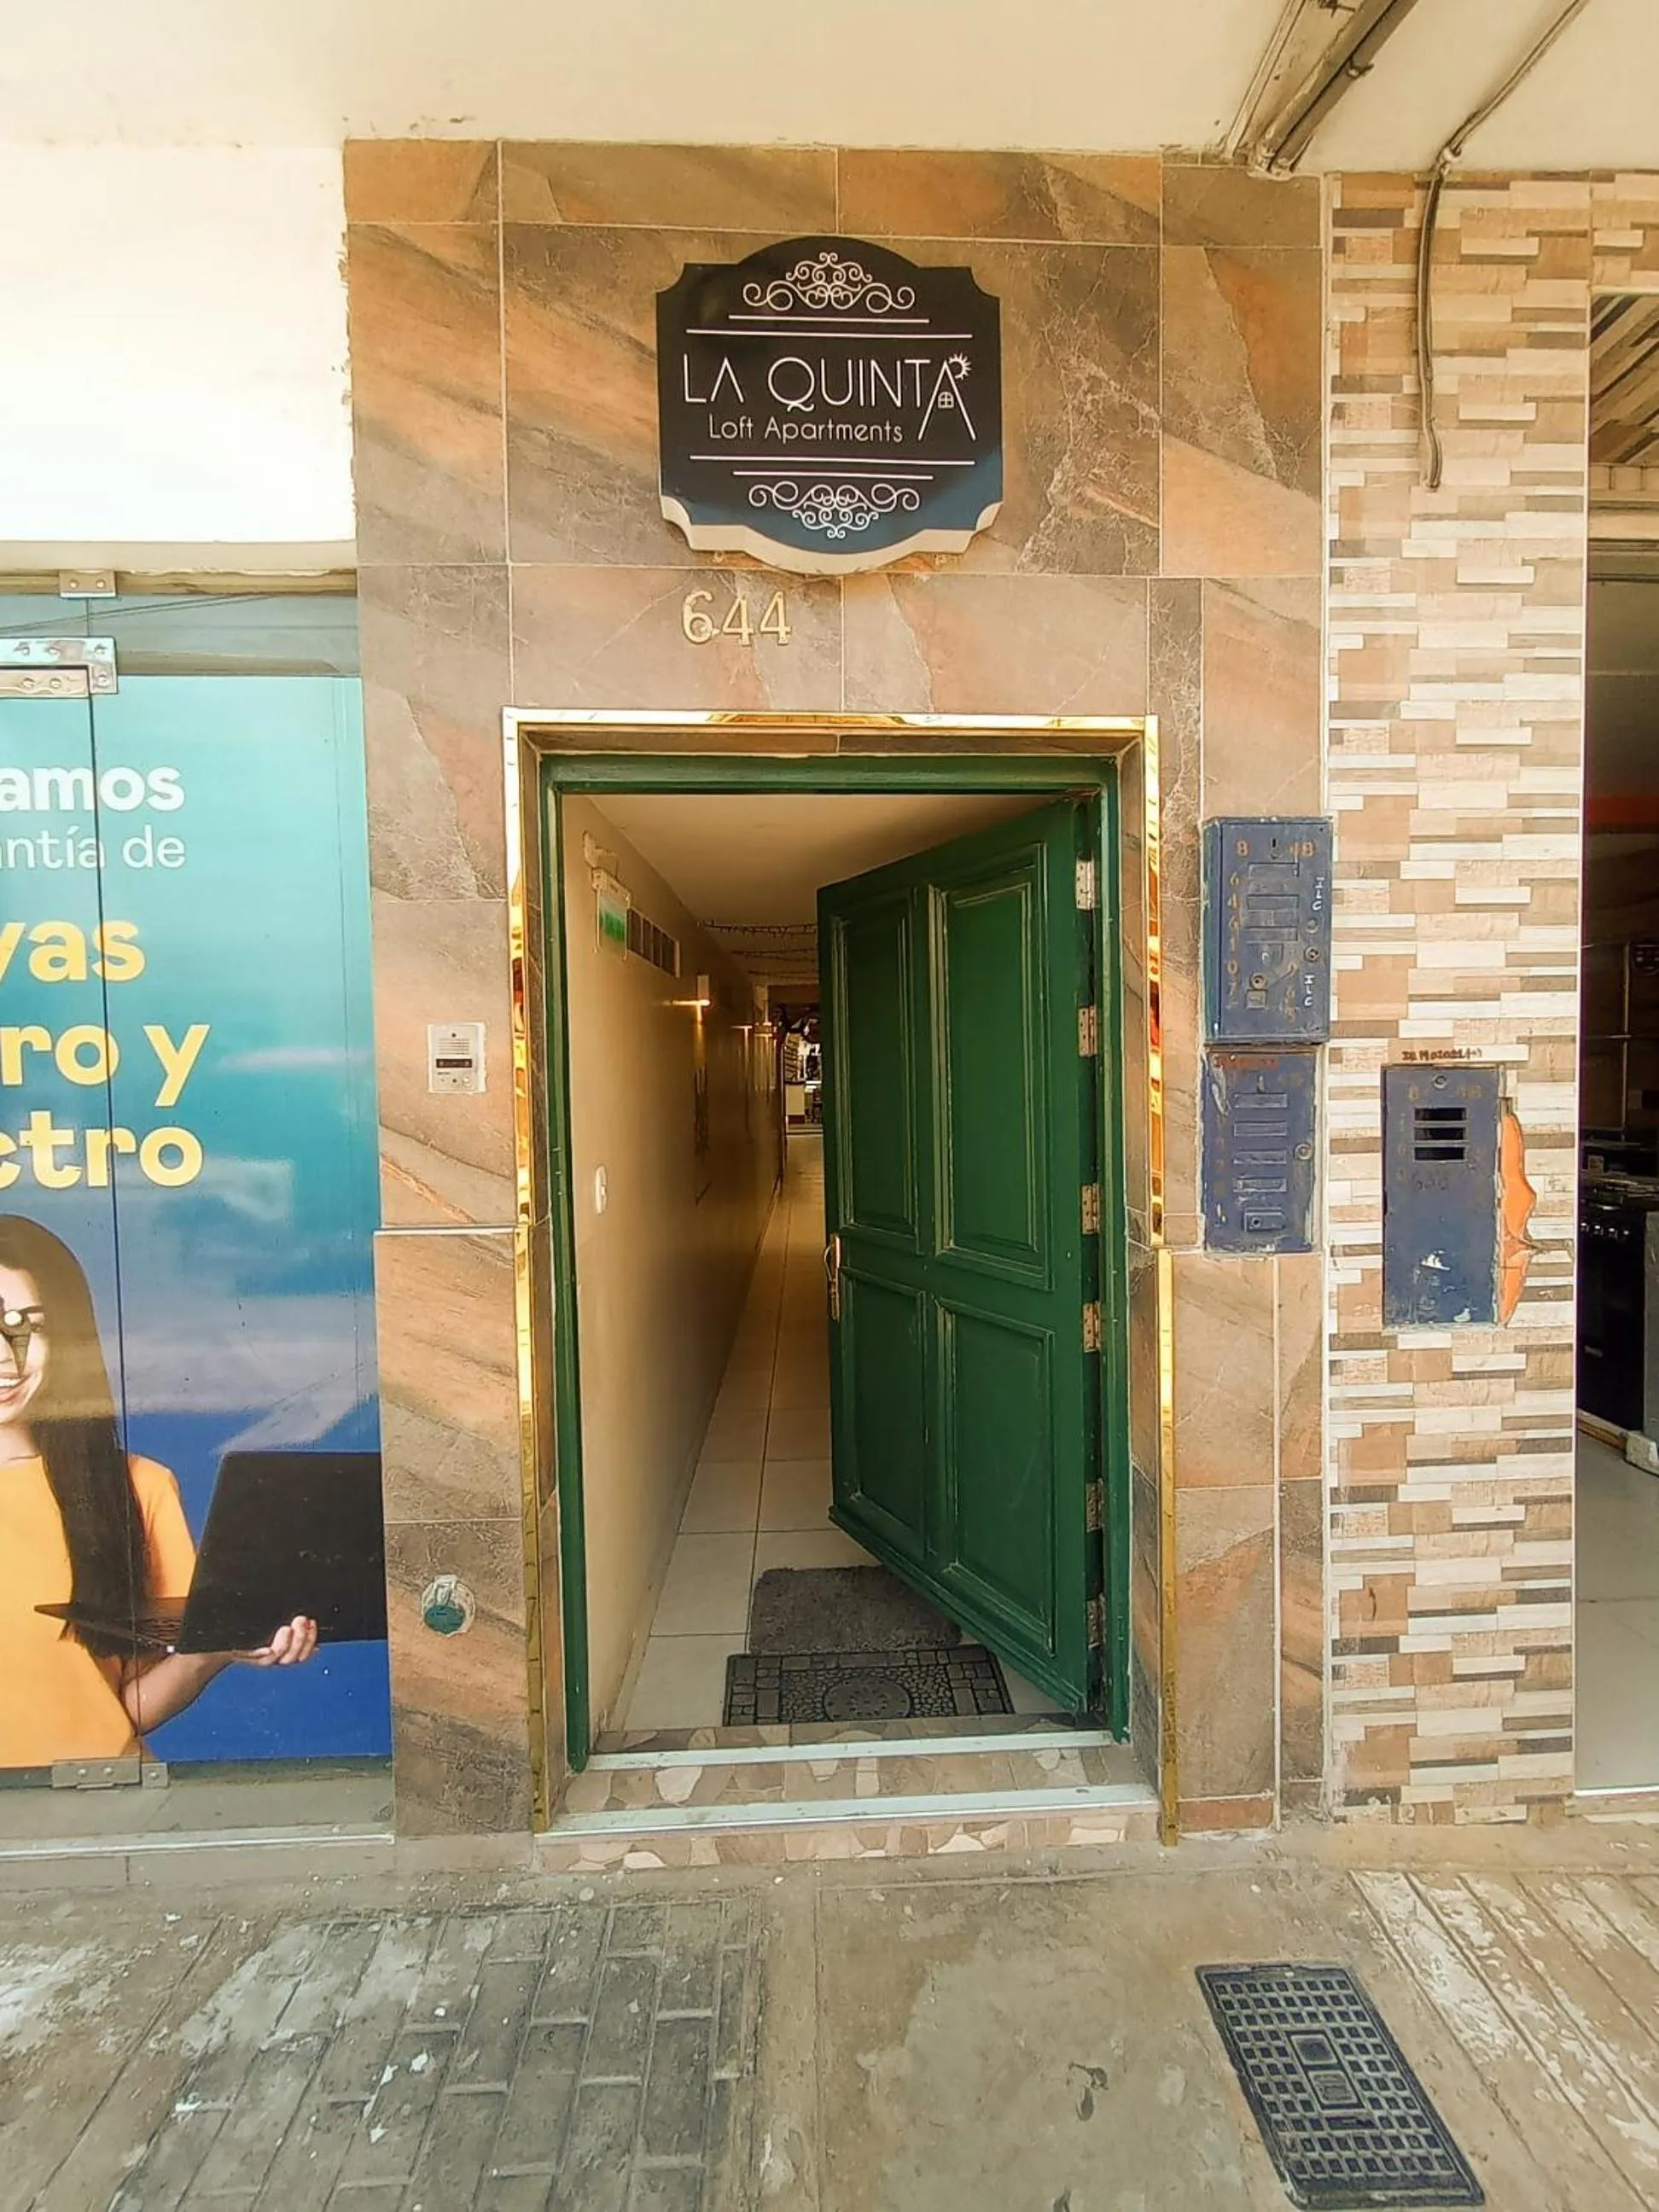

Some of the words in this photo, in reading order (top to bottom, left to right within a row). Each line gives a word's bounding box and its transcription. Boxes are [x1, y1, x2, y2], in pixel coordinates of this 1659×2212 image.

[683, 352, 745, 404] LA
[767, 352, 976, 441] QUINTA
[707, 413, 754, 440] Loft
[765, 416, 903, 444] Apartments
[682, 590, 793, 647] 644
[0, 825, 106, 869] ntía
[123, 824, 186, 869] de
[142, 1024, 211, 1107] y
